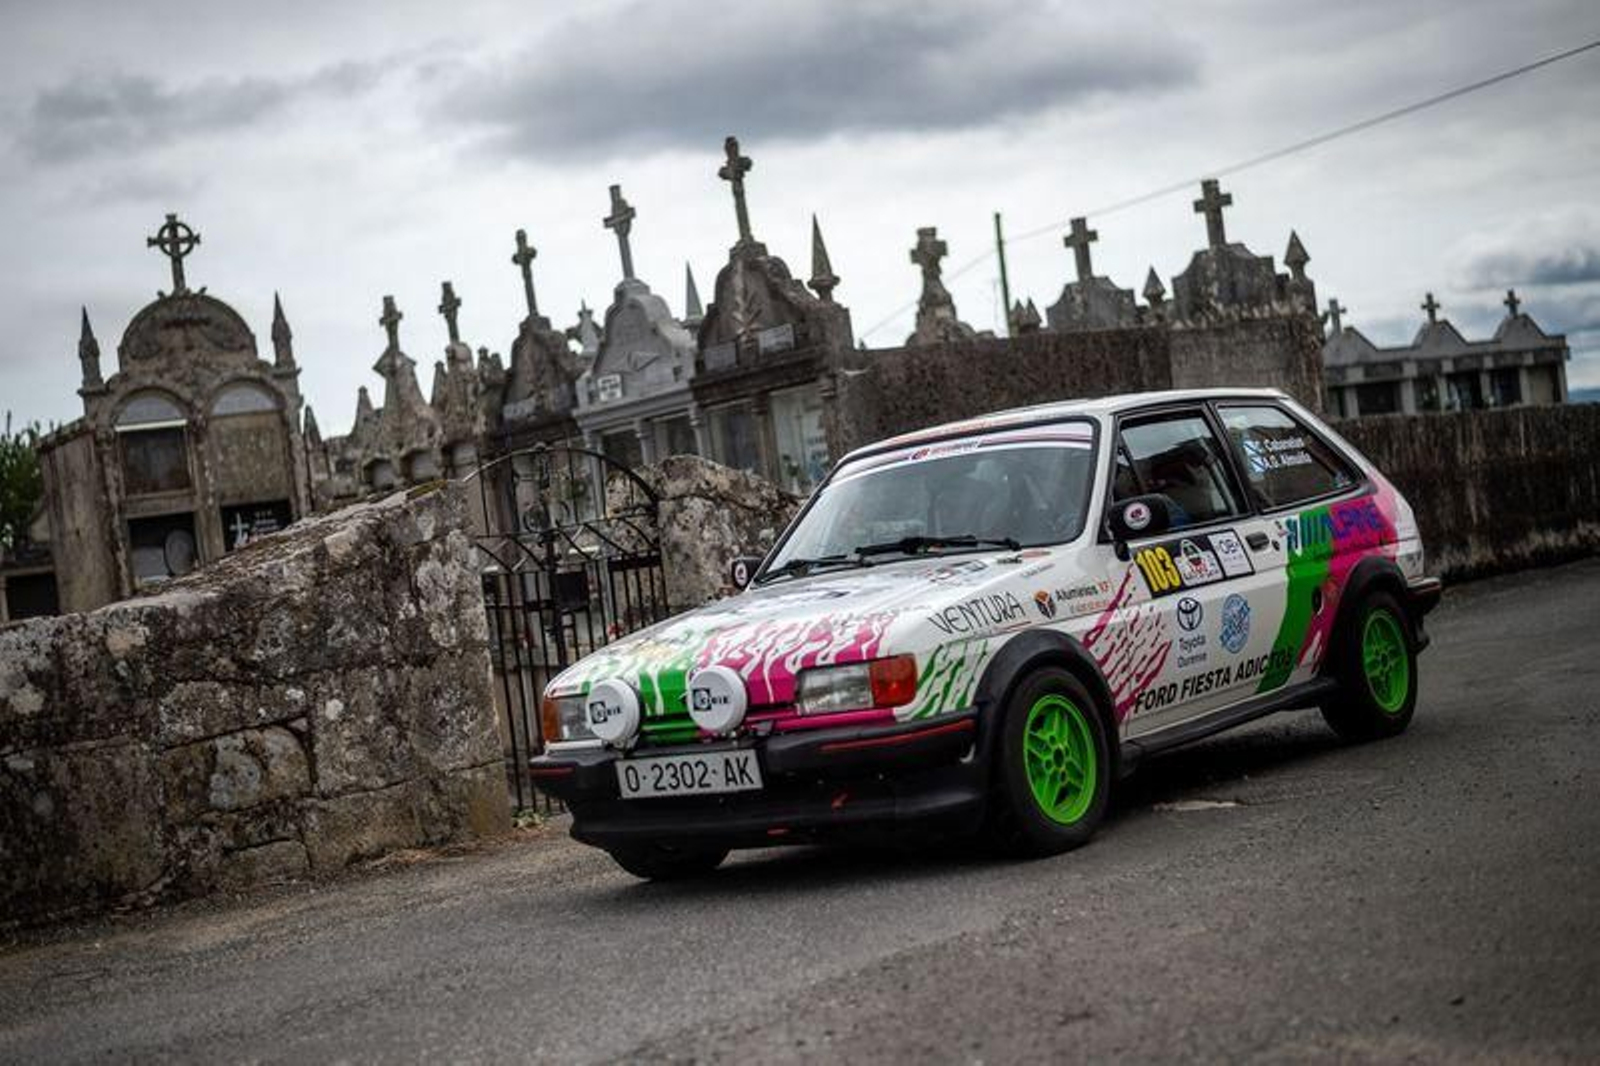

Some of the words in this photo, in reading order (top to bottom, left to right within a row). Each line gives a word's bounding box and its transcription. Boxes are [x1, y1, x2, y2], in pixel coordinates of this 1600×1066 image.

[1136, 545, 1181, 593] 103
[927, 591, 1026, 635] VENTURA
[1178, 634, 1207, 654] Toyota
[1134, 683, 1178, 714] FORD
[1180, 667, 1232, 700] FIESTA
[1233, 647, 1294, 684] ADICTOS
